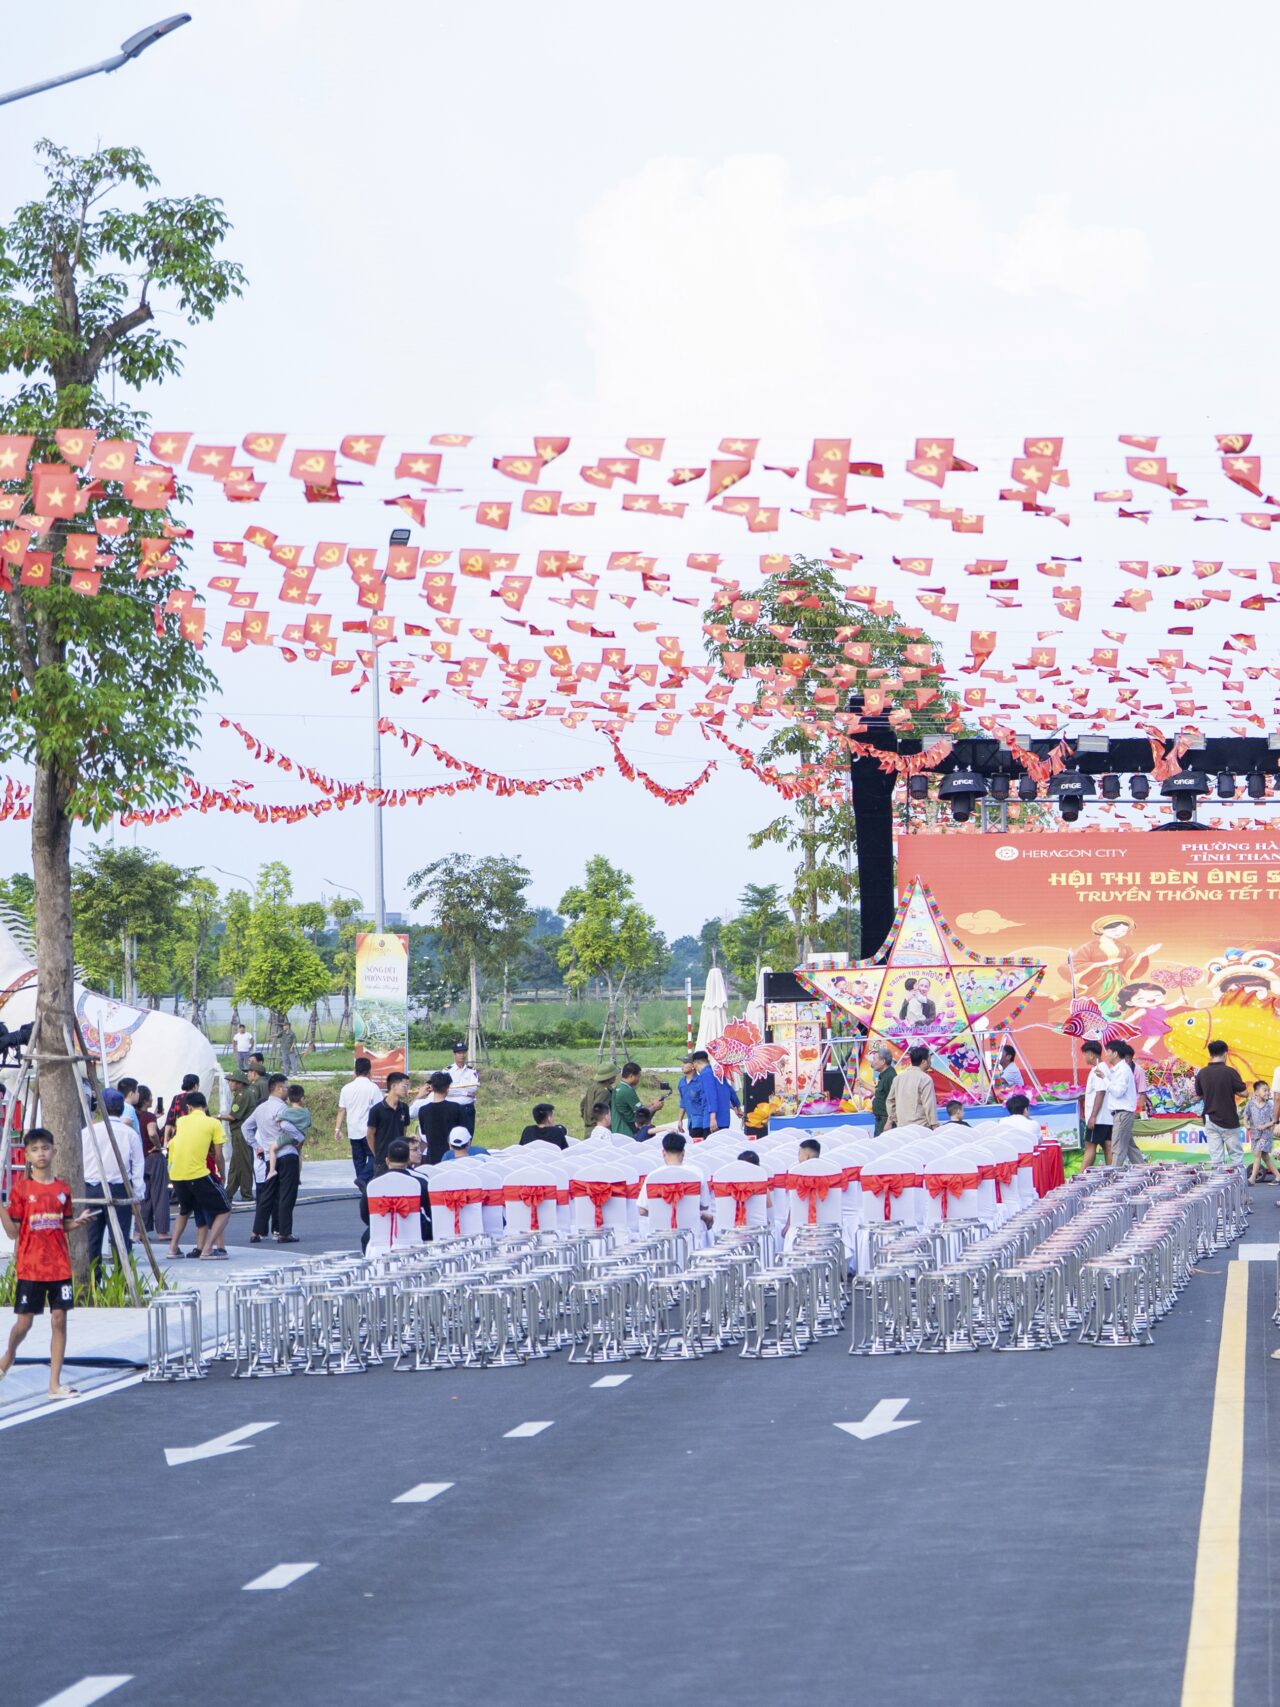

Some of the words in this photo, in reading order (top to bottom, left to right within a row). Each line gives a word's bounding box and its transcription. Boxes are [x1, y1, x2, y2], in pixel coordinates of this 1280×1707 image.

[1181, 841, 1250, 851] PHƯỜNG
[1022, 849, 1092, 859] HERAGON
[1095, 848, 1127, 858] CITY
[1048, 870, 1093, 888] HỘI
[1100, 871, 1141, 885] THI
[1149, 869, 1198, 885] ĐÈN
[1207, 868, 1258, 884] ÔNG
[1076, 887, 1151, 902] TRUYỀN
[1156, 886, 1223, 901] THỐNG
[1228, 885, 1263, 900] TẾT
